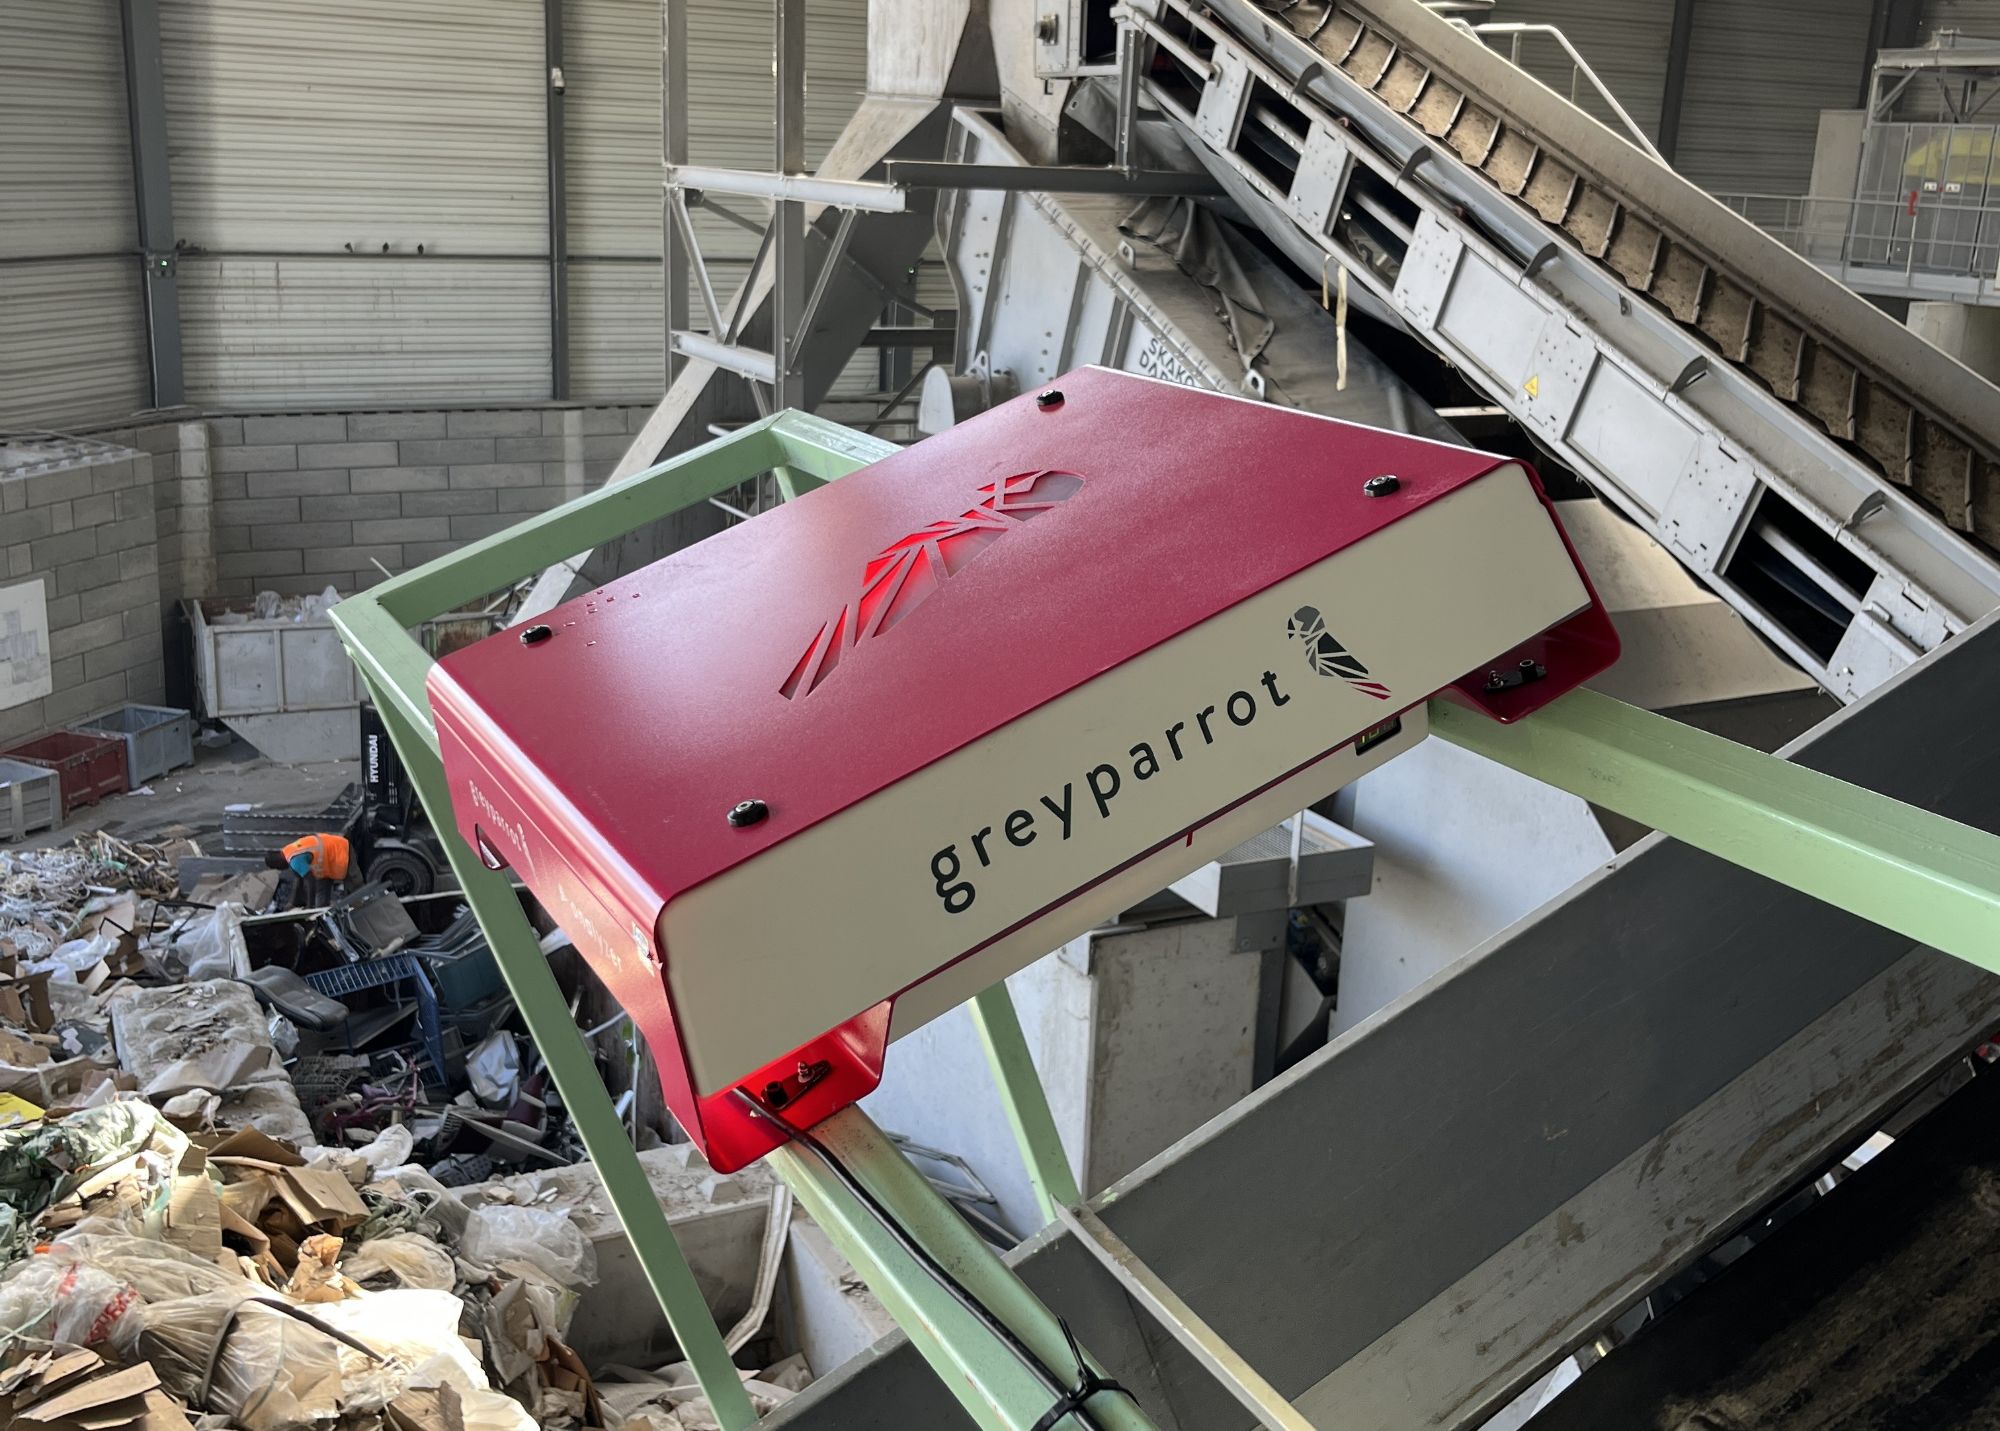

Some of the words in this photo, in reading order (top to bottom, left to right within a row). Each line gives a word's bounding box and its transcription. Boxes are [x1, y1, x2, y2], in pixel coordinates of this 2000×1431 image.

[1149, 338, 1195, 387] SKAKO
[368, 734, 379, 783] HYUNDAI
[931, 670, 1292, 915] greyparrot
